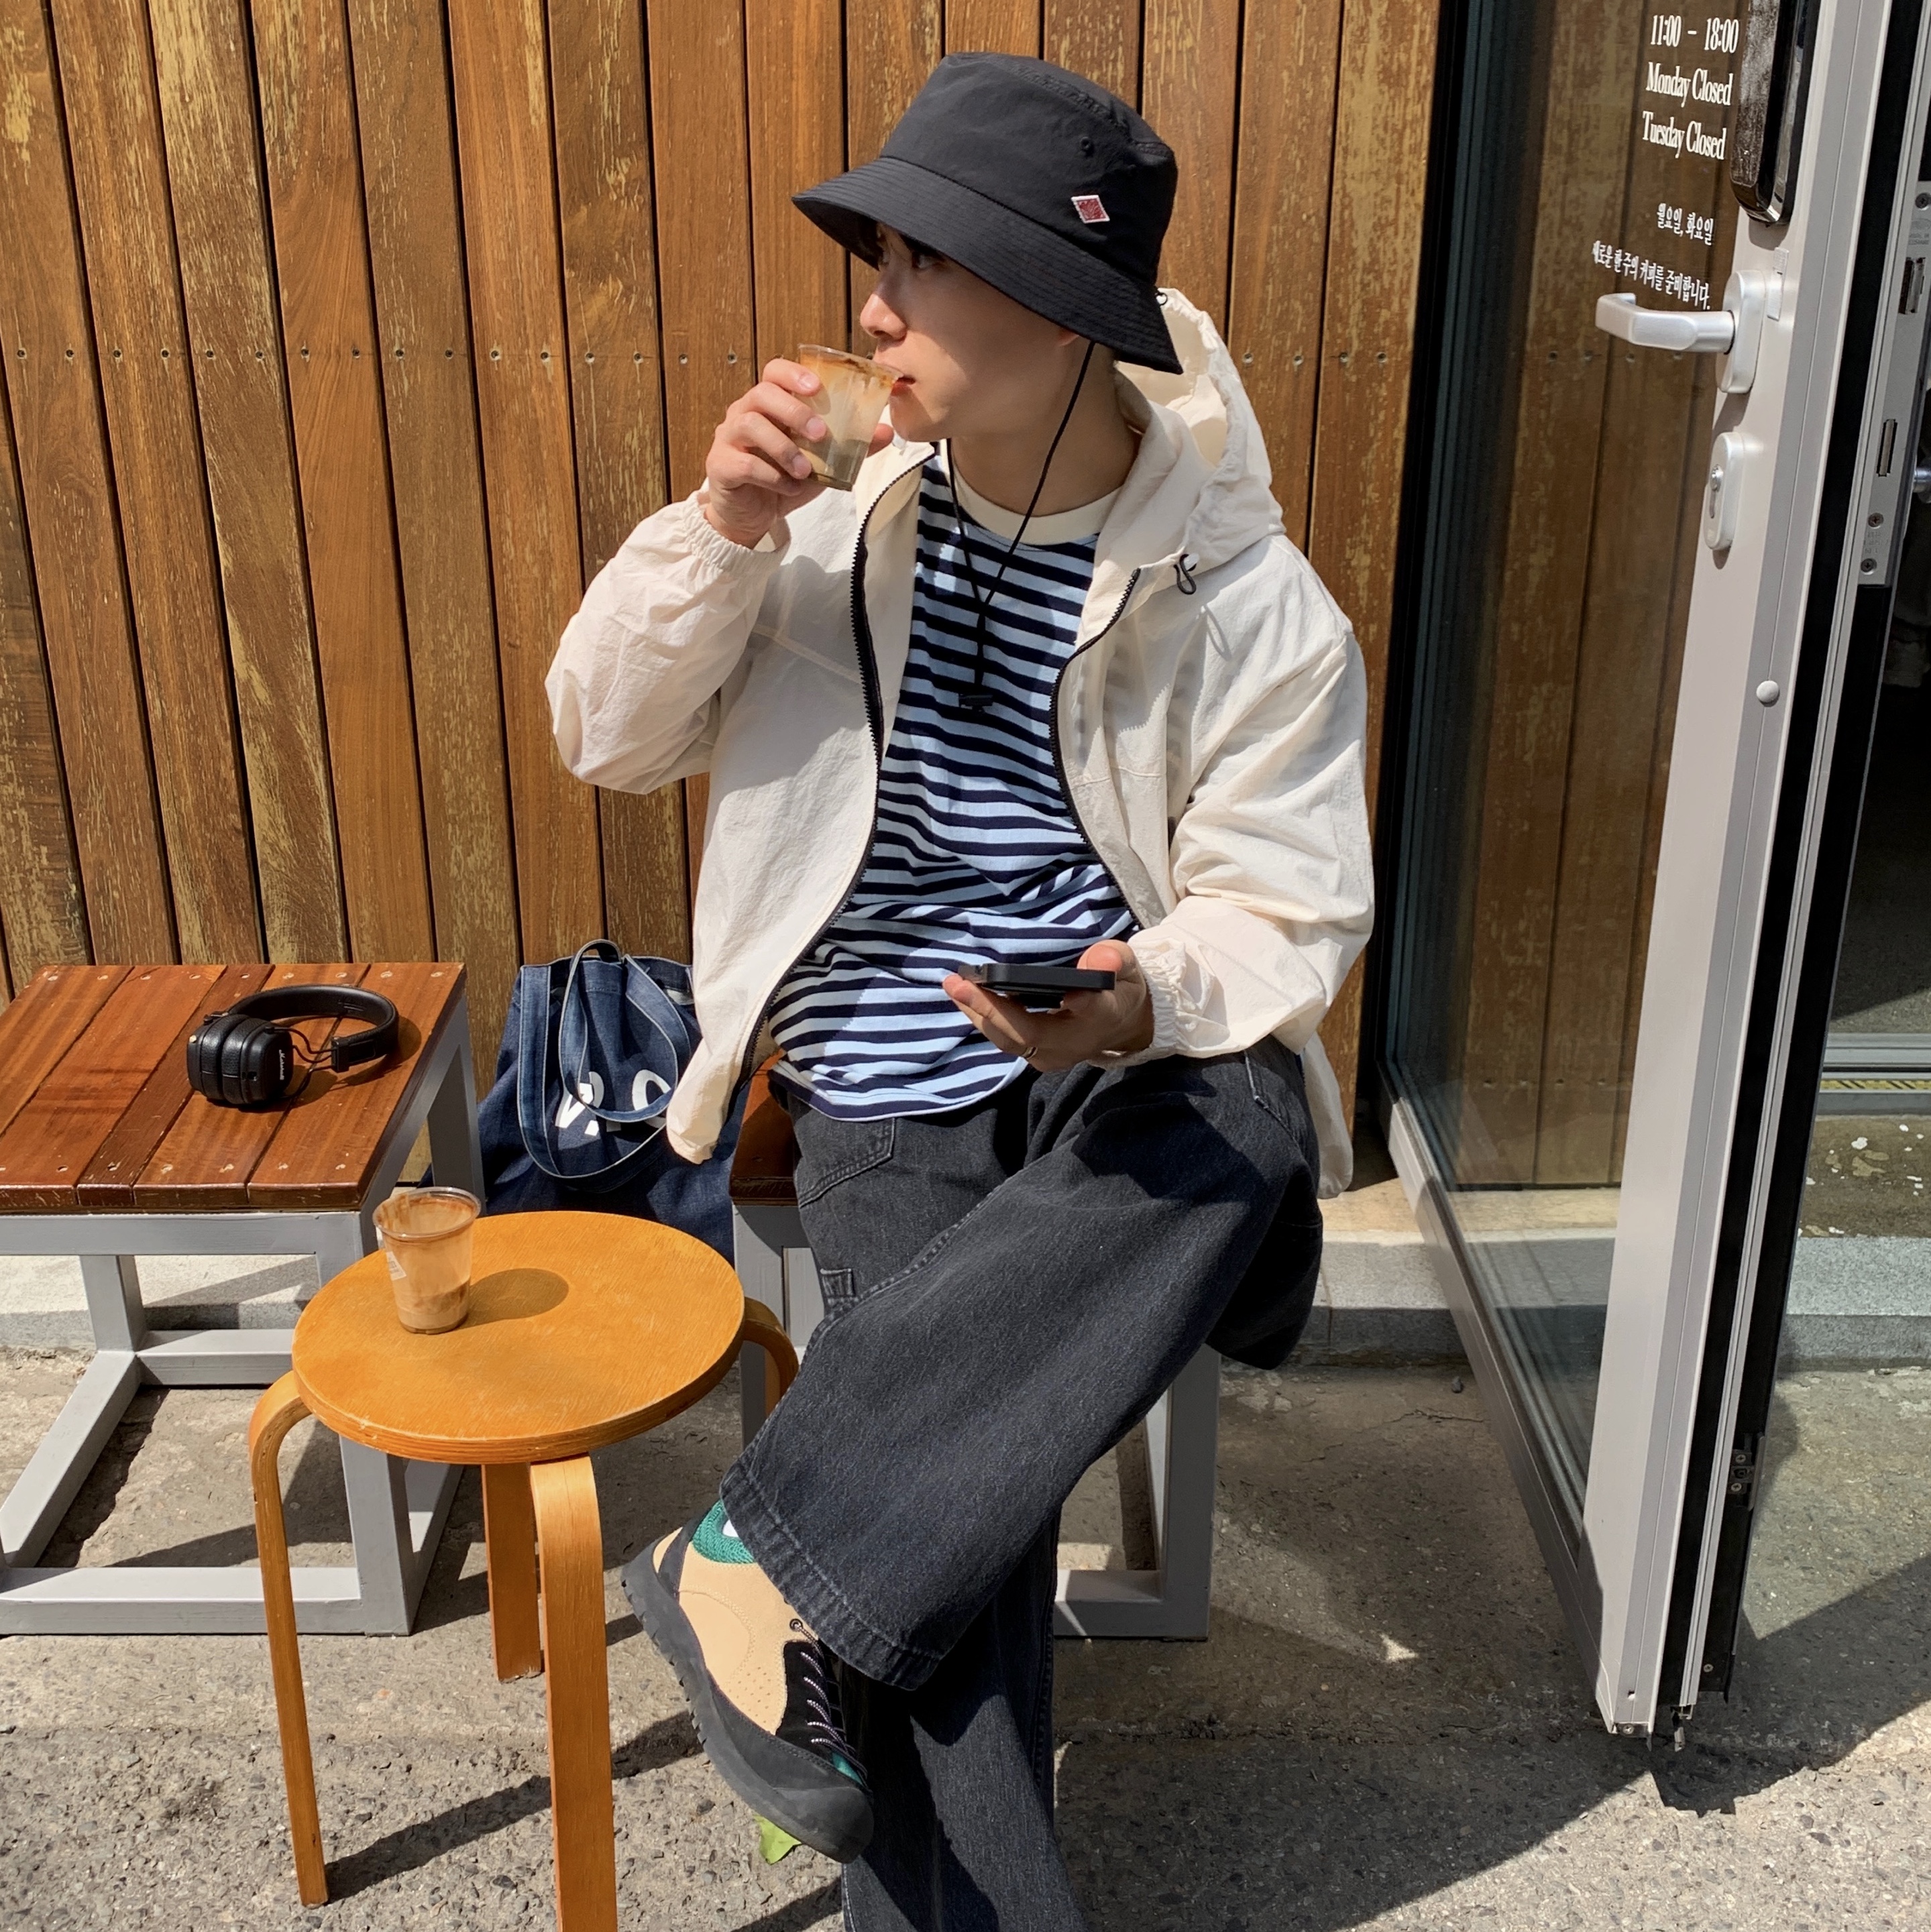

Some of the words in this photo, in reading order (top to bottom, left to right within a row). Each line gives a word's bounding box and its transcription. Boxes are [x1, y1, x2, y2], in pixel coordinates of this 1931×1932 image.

[1651, 15, 1681, 47] 11:00
[1704, 17, 1739, 54] 18:00
[1645, 62, 1692, 108] Monday
[1692, 68, 1733, 106] Closed
[1643, 111, 1685, 158] Tuesday
[1686, 121, 1727, 160] Closed
[1657, 203, 1683, 237] 월요일,
[1686, 212, 1714, 246] 화요일
[1640, 259, 1664, 291] 커피를
[1665, 270, 1710, 310] 준비합니다.
